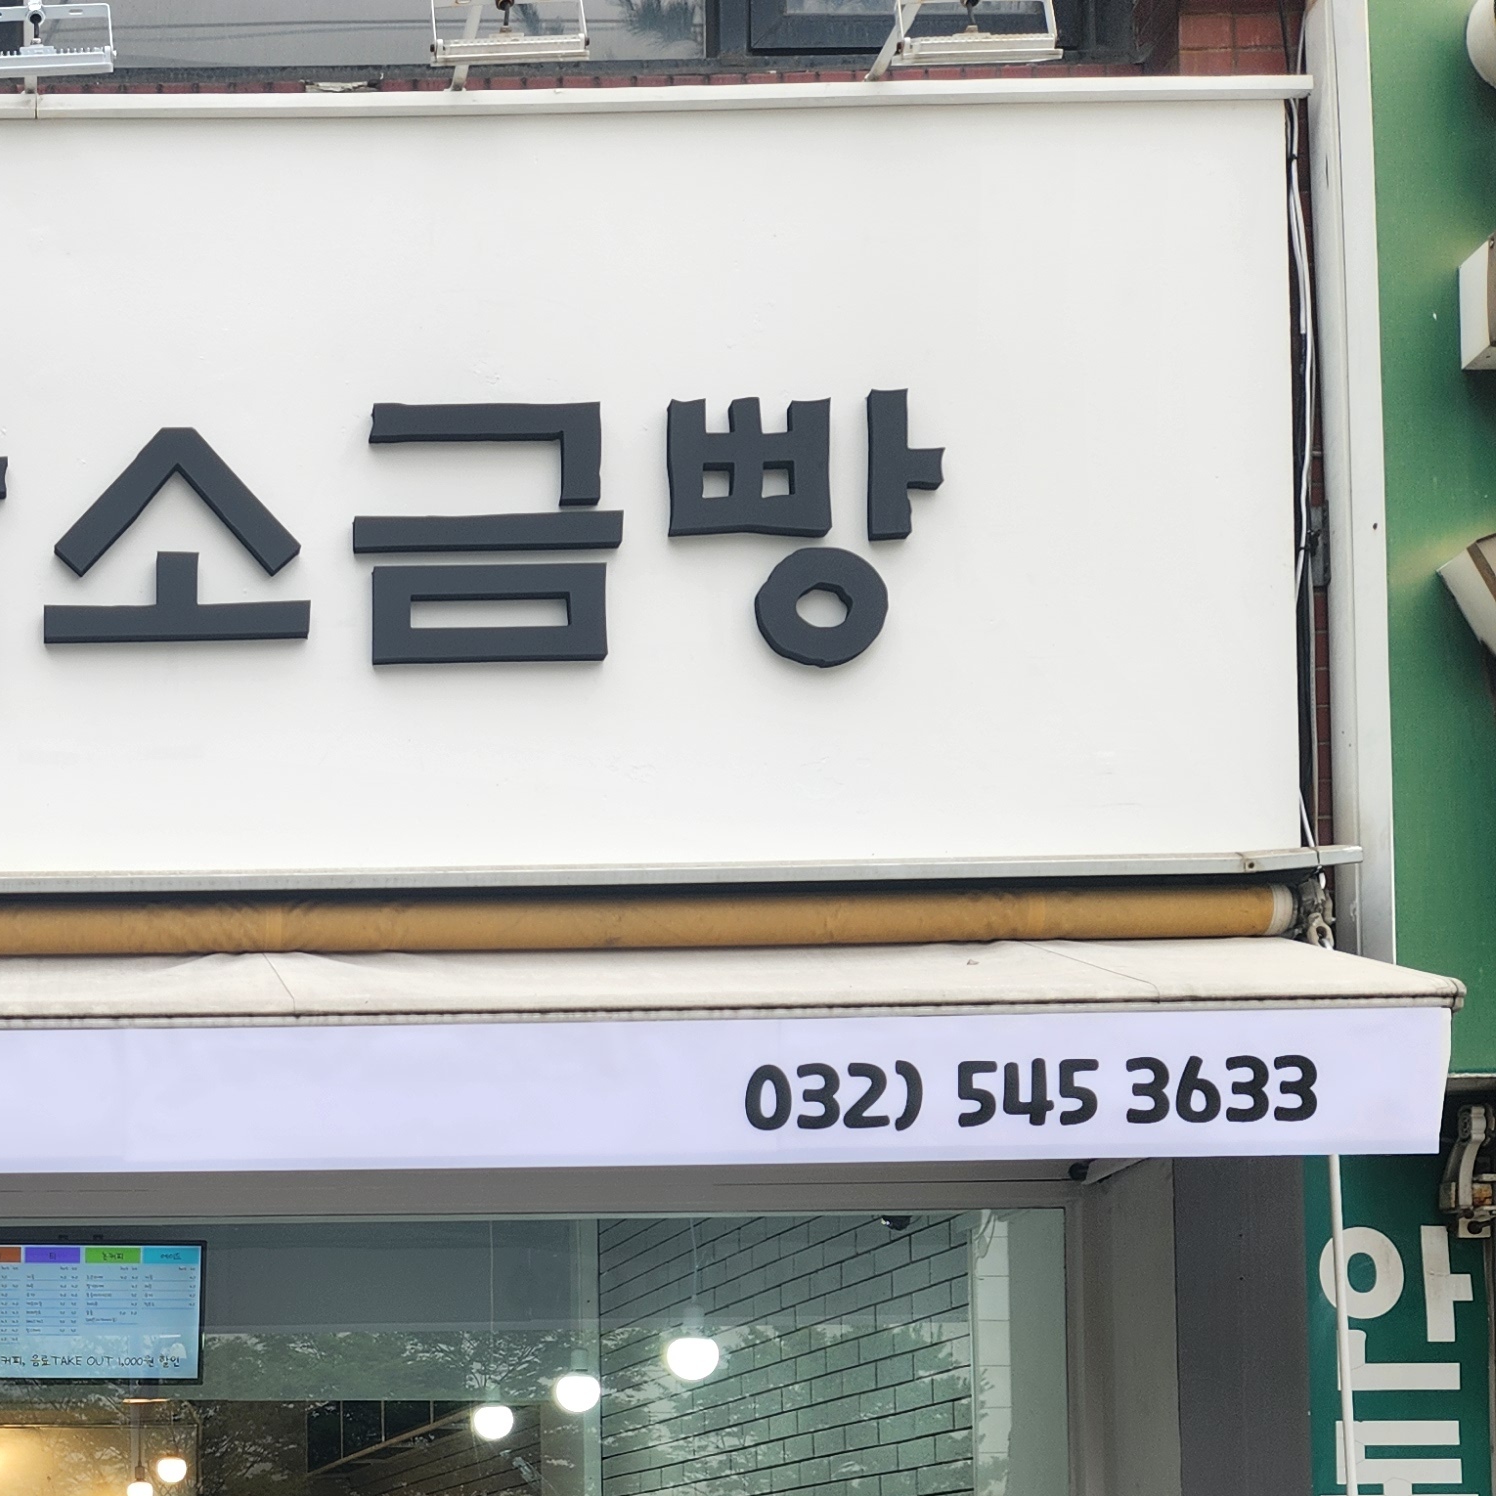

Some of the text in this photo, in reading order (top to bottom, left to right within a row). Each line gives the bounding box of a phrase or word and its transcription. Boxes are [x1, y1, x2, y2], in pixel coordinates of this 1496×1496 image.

[745, 1055, 1318, 1132] 032) 545 3633
[86, 1355, 113, 1367] OUT
